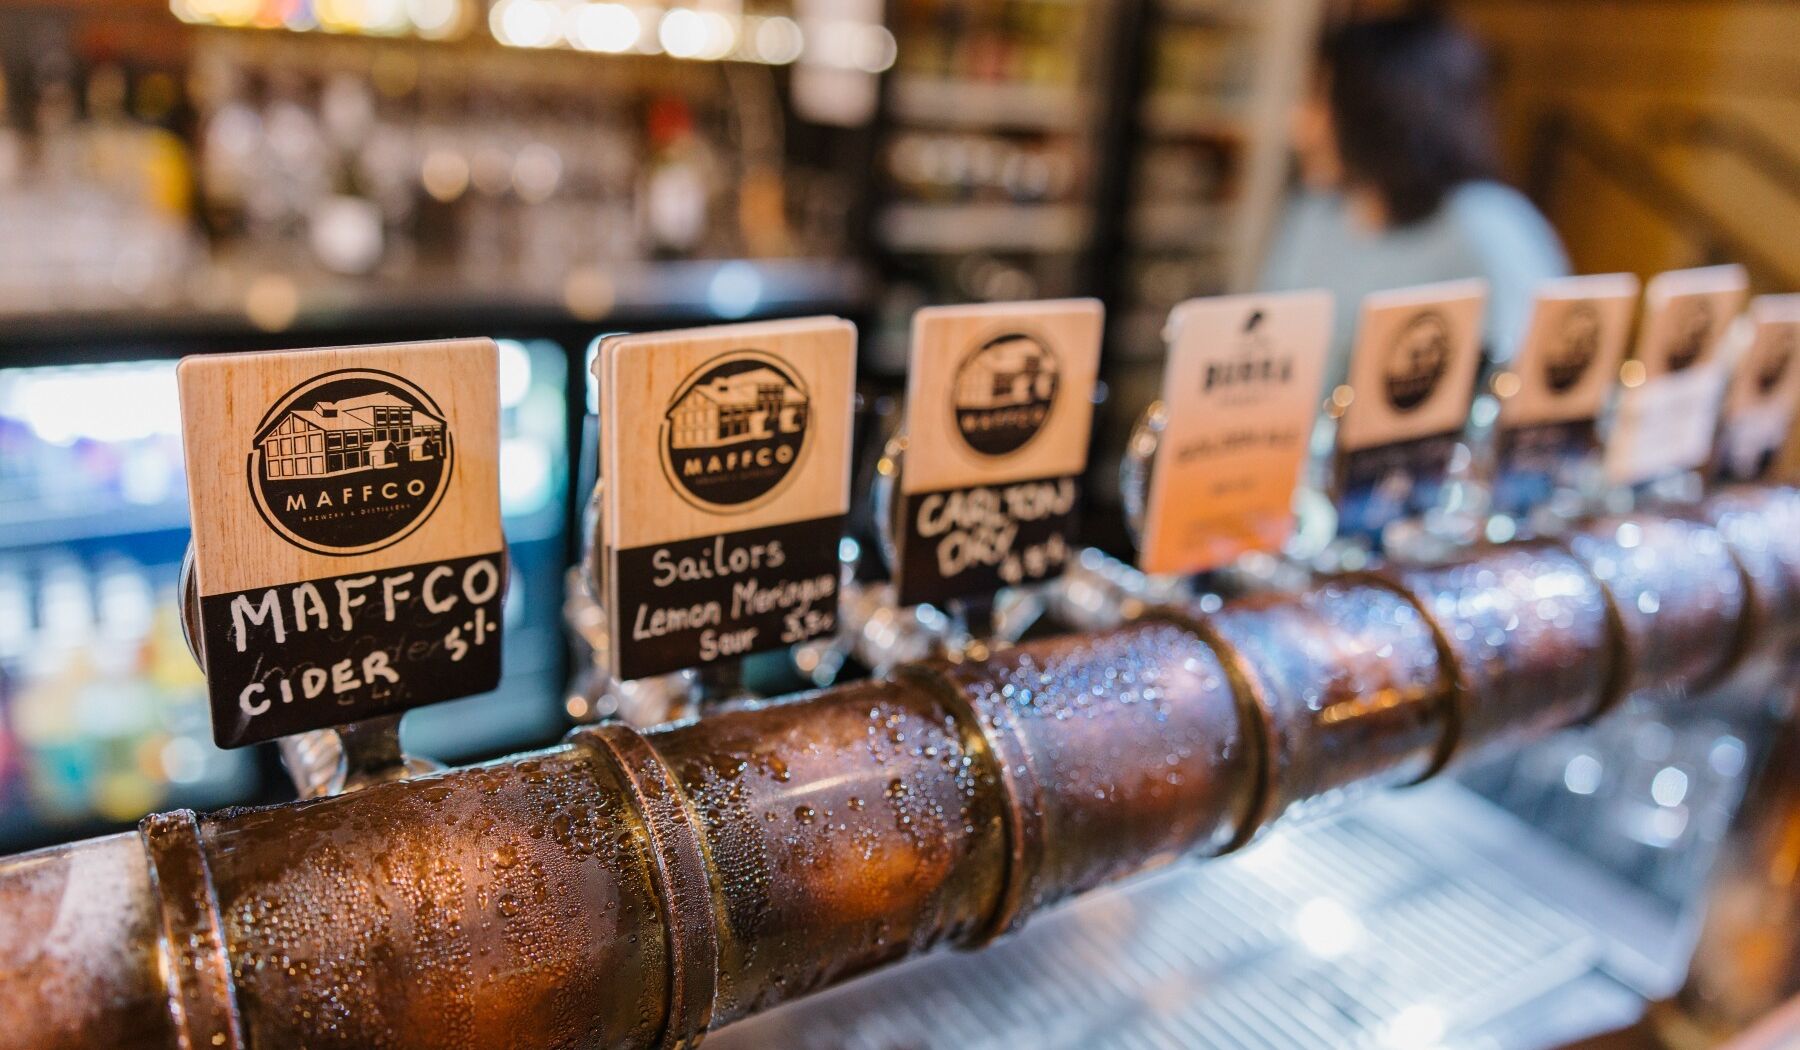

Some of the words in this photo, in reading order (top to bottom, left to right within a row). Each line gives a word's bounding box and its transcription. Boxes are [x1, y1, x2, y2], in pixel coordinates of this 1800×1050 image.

[684, 444, 794, 477] MAFFCO
[286, 479, 425, 512] MAFFCO
[652, 535, 786, 588] Sailors
[230, 559, 499, 653] MAFFCO
[633, 600, 722, 641] Lemon
[444, 607, 497, 662] 5%
[700, 627, 760, 661] Sour
[238, 650, 400, 716] CIDER
